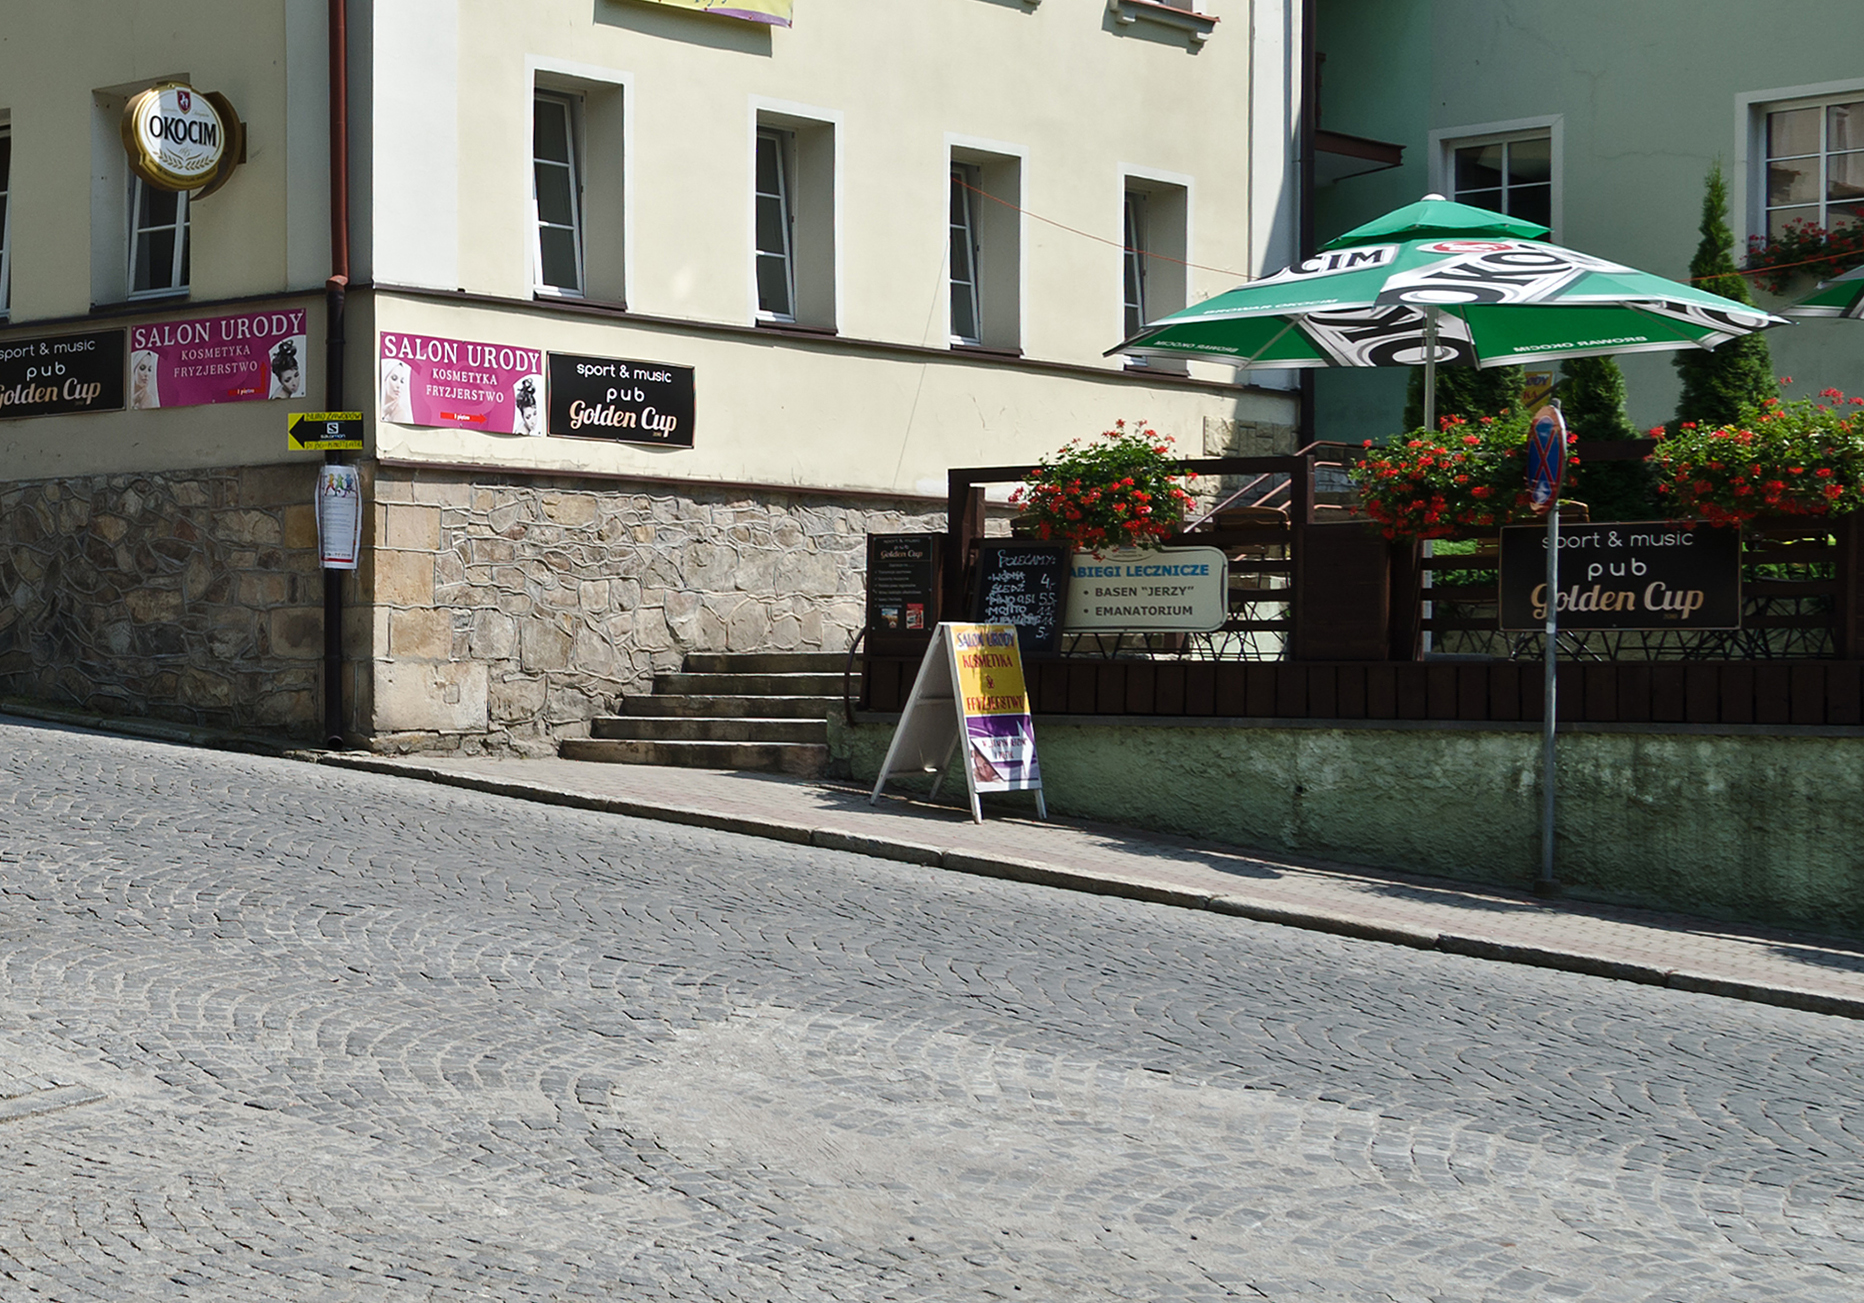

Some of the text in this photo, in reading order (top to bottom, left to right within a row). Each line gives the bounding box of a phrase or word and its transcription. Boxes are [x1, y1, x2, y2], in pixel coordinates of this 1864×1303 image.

[149, 115, 217, 148] OKOCIM
[135, 312, 305, 349] SALON URODY
[39, 342, 50, 356] &
[53, 338, 96, 354] music
[181, 344, 251, 361] KOSMETYKA
[384, 335, 540, 373] SALON URODY
[26, 361, 66, 381] pub
[173, 361, 258, 378] FRYZJERSTWO
[432, 367, 498, 386] KOSMETYKA
[576, 362, 672, 383] sport & music
[62, 378, 101, 405] Cup
[426, 384, 504, 403] FRYZJERSTWO
[606, 387, 645, 403] pub
[569, 400, 677, 438] Golden Cup
[1607, 530, 1623, 547] &
[1630, 530, 1694, 547] music
[880, 550, 923, 559] Golden Cup
[1070, 564, 1209, 578] ABIEGI LECZNICZE
[1587, 558, 1648, 581] pub
[1095, 587, 1137, 597] BASEN
[1530, 581, 1704, 620] Golden Cup
[1095, 606, 1193, 616] EMANATORIUM
[956, 632, 983, 647] SALON
[962, 653, 1013, 668] KOSMETYKA
